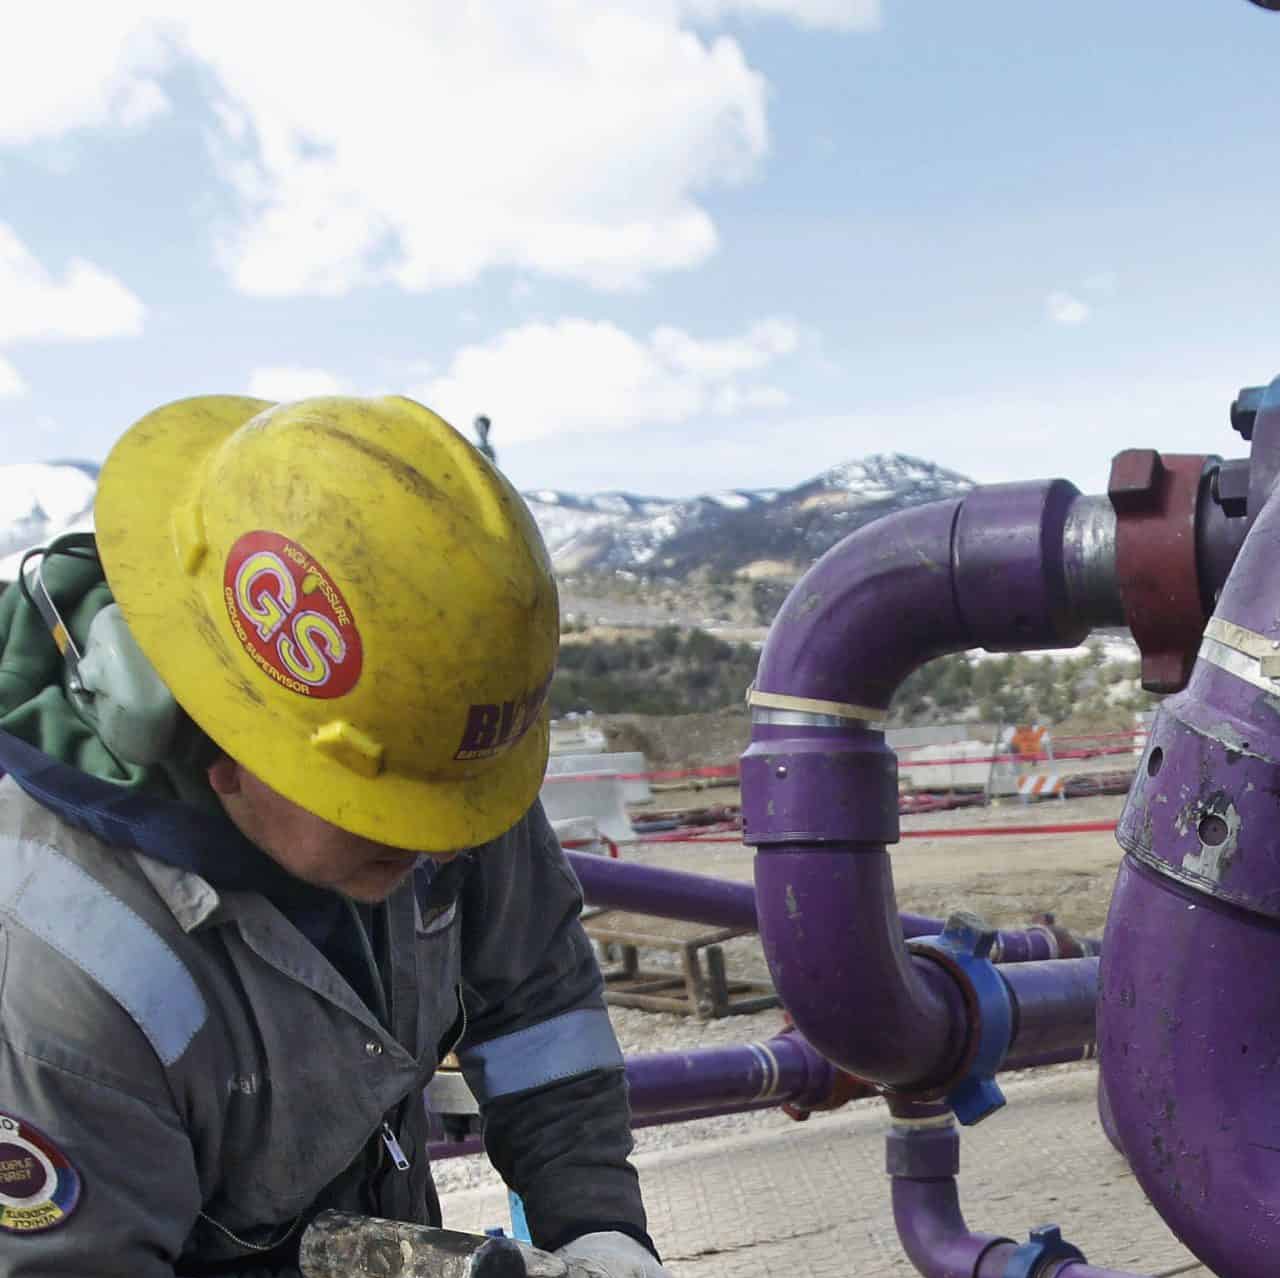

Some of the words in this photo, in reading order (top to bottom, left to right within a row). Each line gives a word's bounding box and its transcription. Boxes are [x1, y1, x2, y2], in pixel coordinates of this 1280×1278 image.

[225, 586, 247, 642] GROUND
[246, 642, 310, 694] SUPERVISOR
[236, 551, 346, 686] GS
